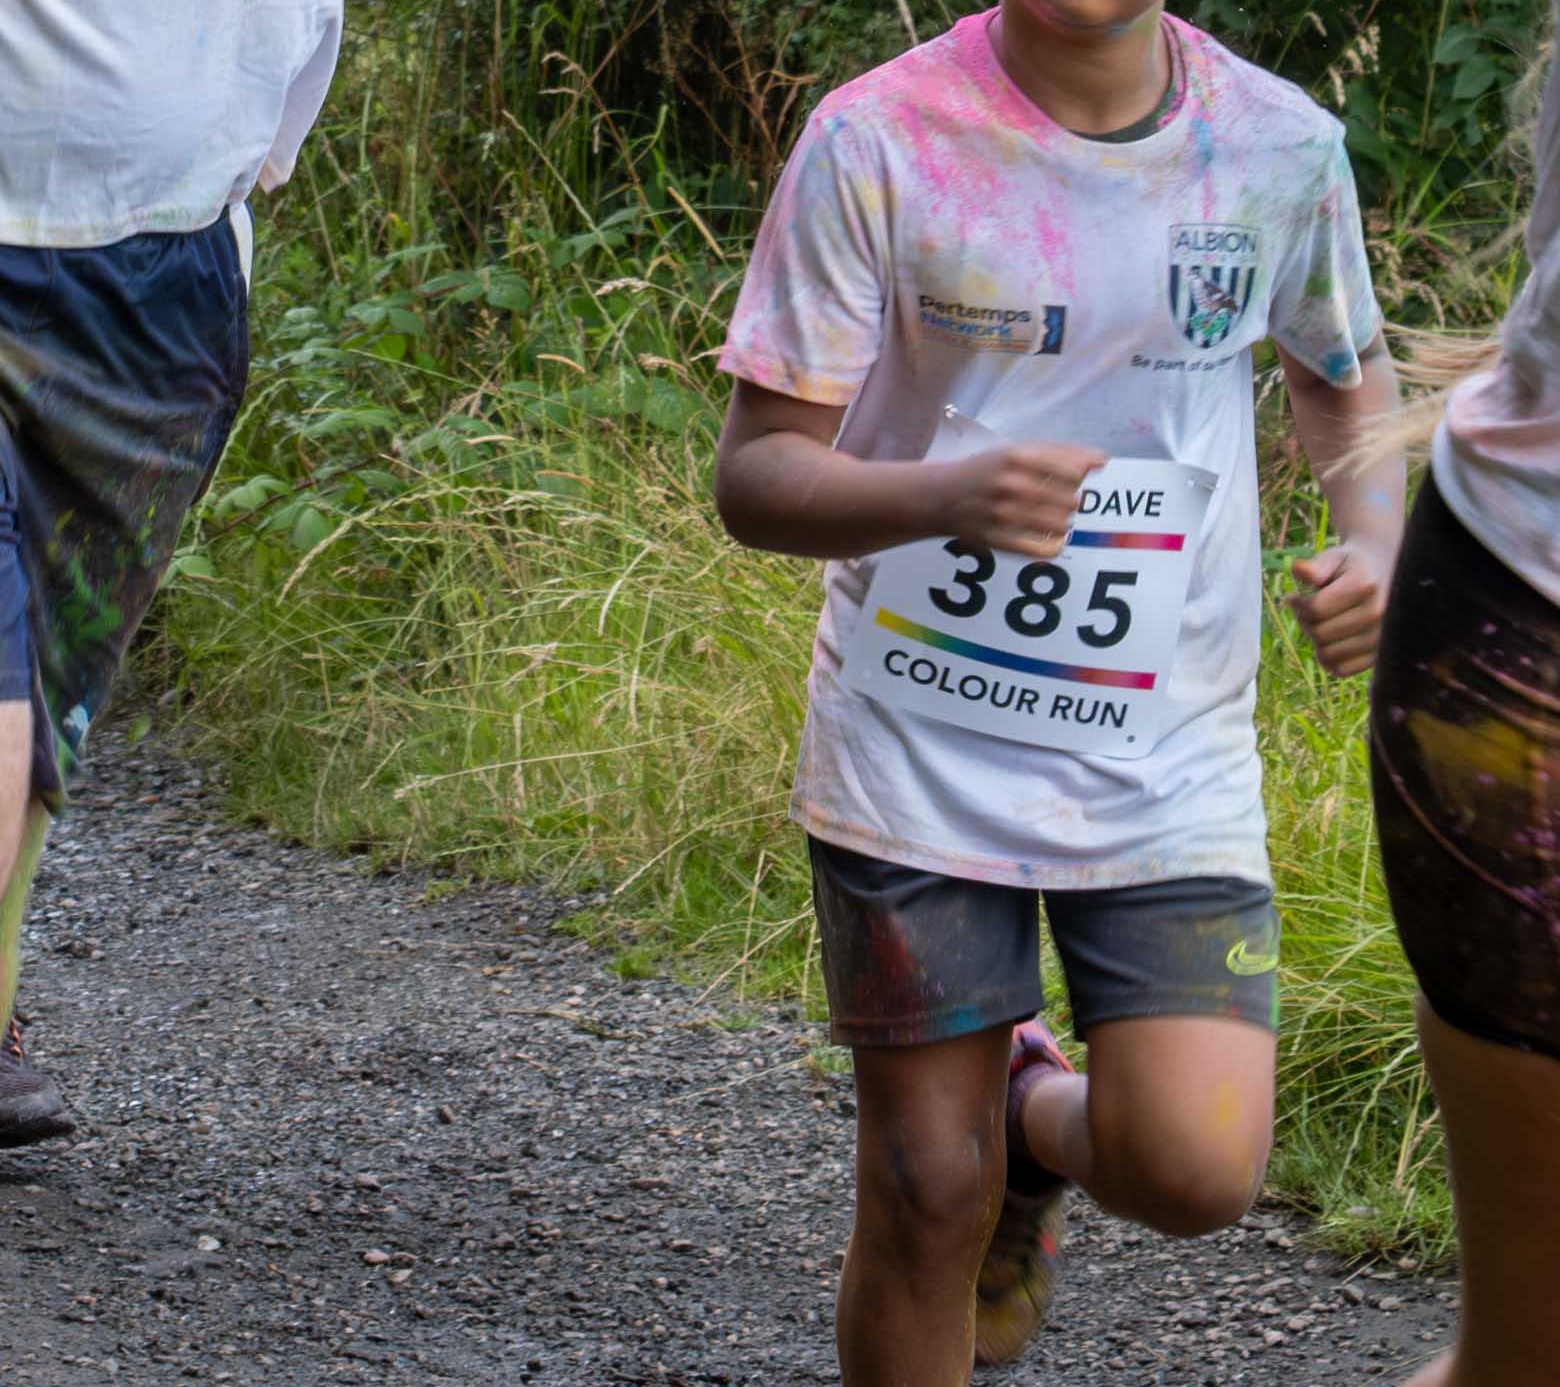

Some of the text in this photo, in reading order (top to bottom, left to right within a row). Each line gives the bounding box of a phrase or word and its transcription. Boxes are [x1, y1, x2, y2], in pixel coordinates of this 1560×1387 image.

[918, 294, 1033, 324] Pertemps
[1076, 489, 1165, 518] DAVE
[927, 537, 1140, 650] 385
[883, 649, 1130, 730] COLOUR RUN
